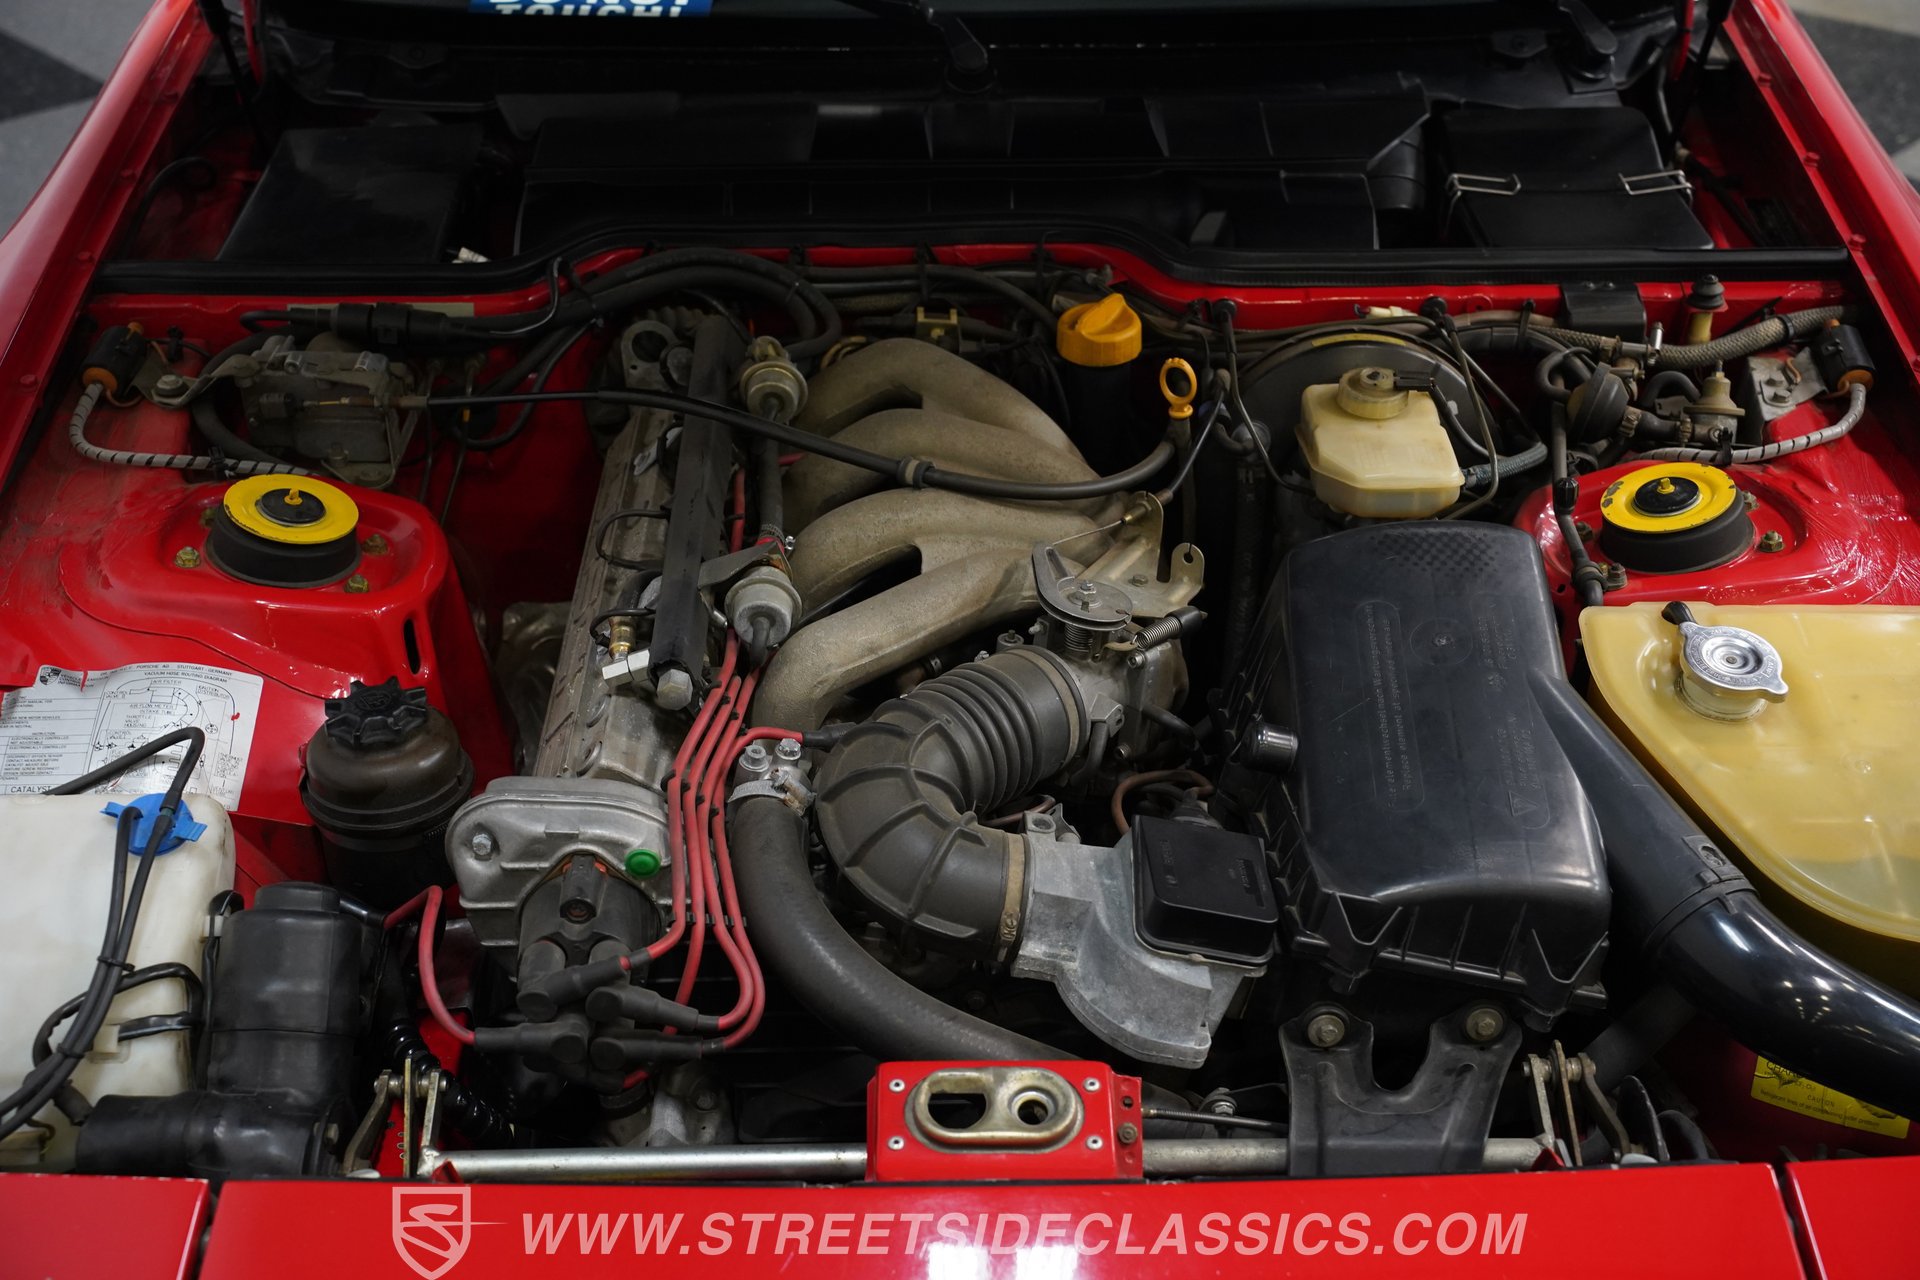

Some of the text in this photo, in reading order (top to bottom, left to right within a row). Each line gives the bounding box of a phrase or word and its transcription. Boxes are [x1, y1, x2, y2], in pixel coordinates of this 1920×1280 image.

[208, 667, 232, 676] GERMANY
[181, 671, 203, 679] ROUTING
[204, 674, 227, 683] DIAGRAM
[10, 785, 51, 794] CATALYST
[1807, 1094, 1835, 1108] CAUTION
